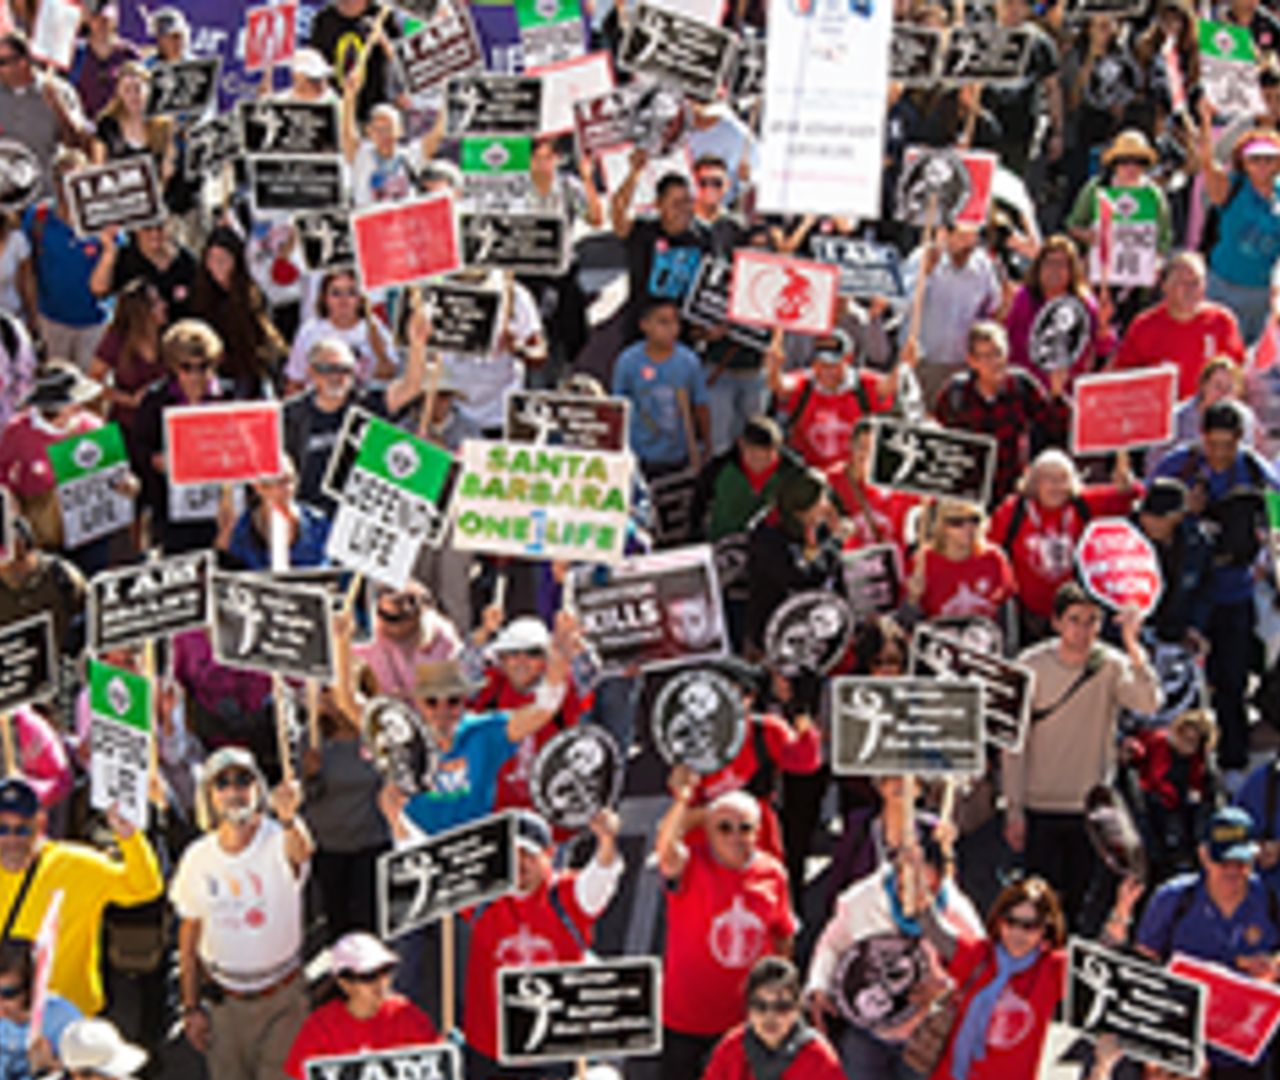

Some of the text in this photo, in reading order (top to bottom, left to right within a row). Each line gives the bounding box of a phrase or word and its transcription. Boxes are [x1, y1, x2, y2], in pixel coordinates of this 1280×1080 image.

[486, 445, 608, 483] SANTA
[460, 472, 625, 512] BARBARA
[458, 510, 618, 551] ONE LIFE
